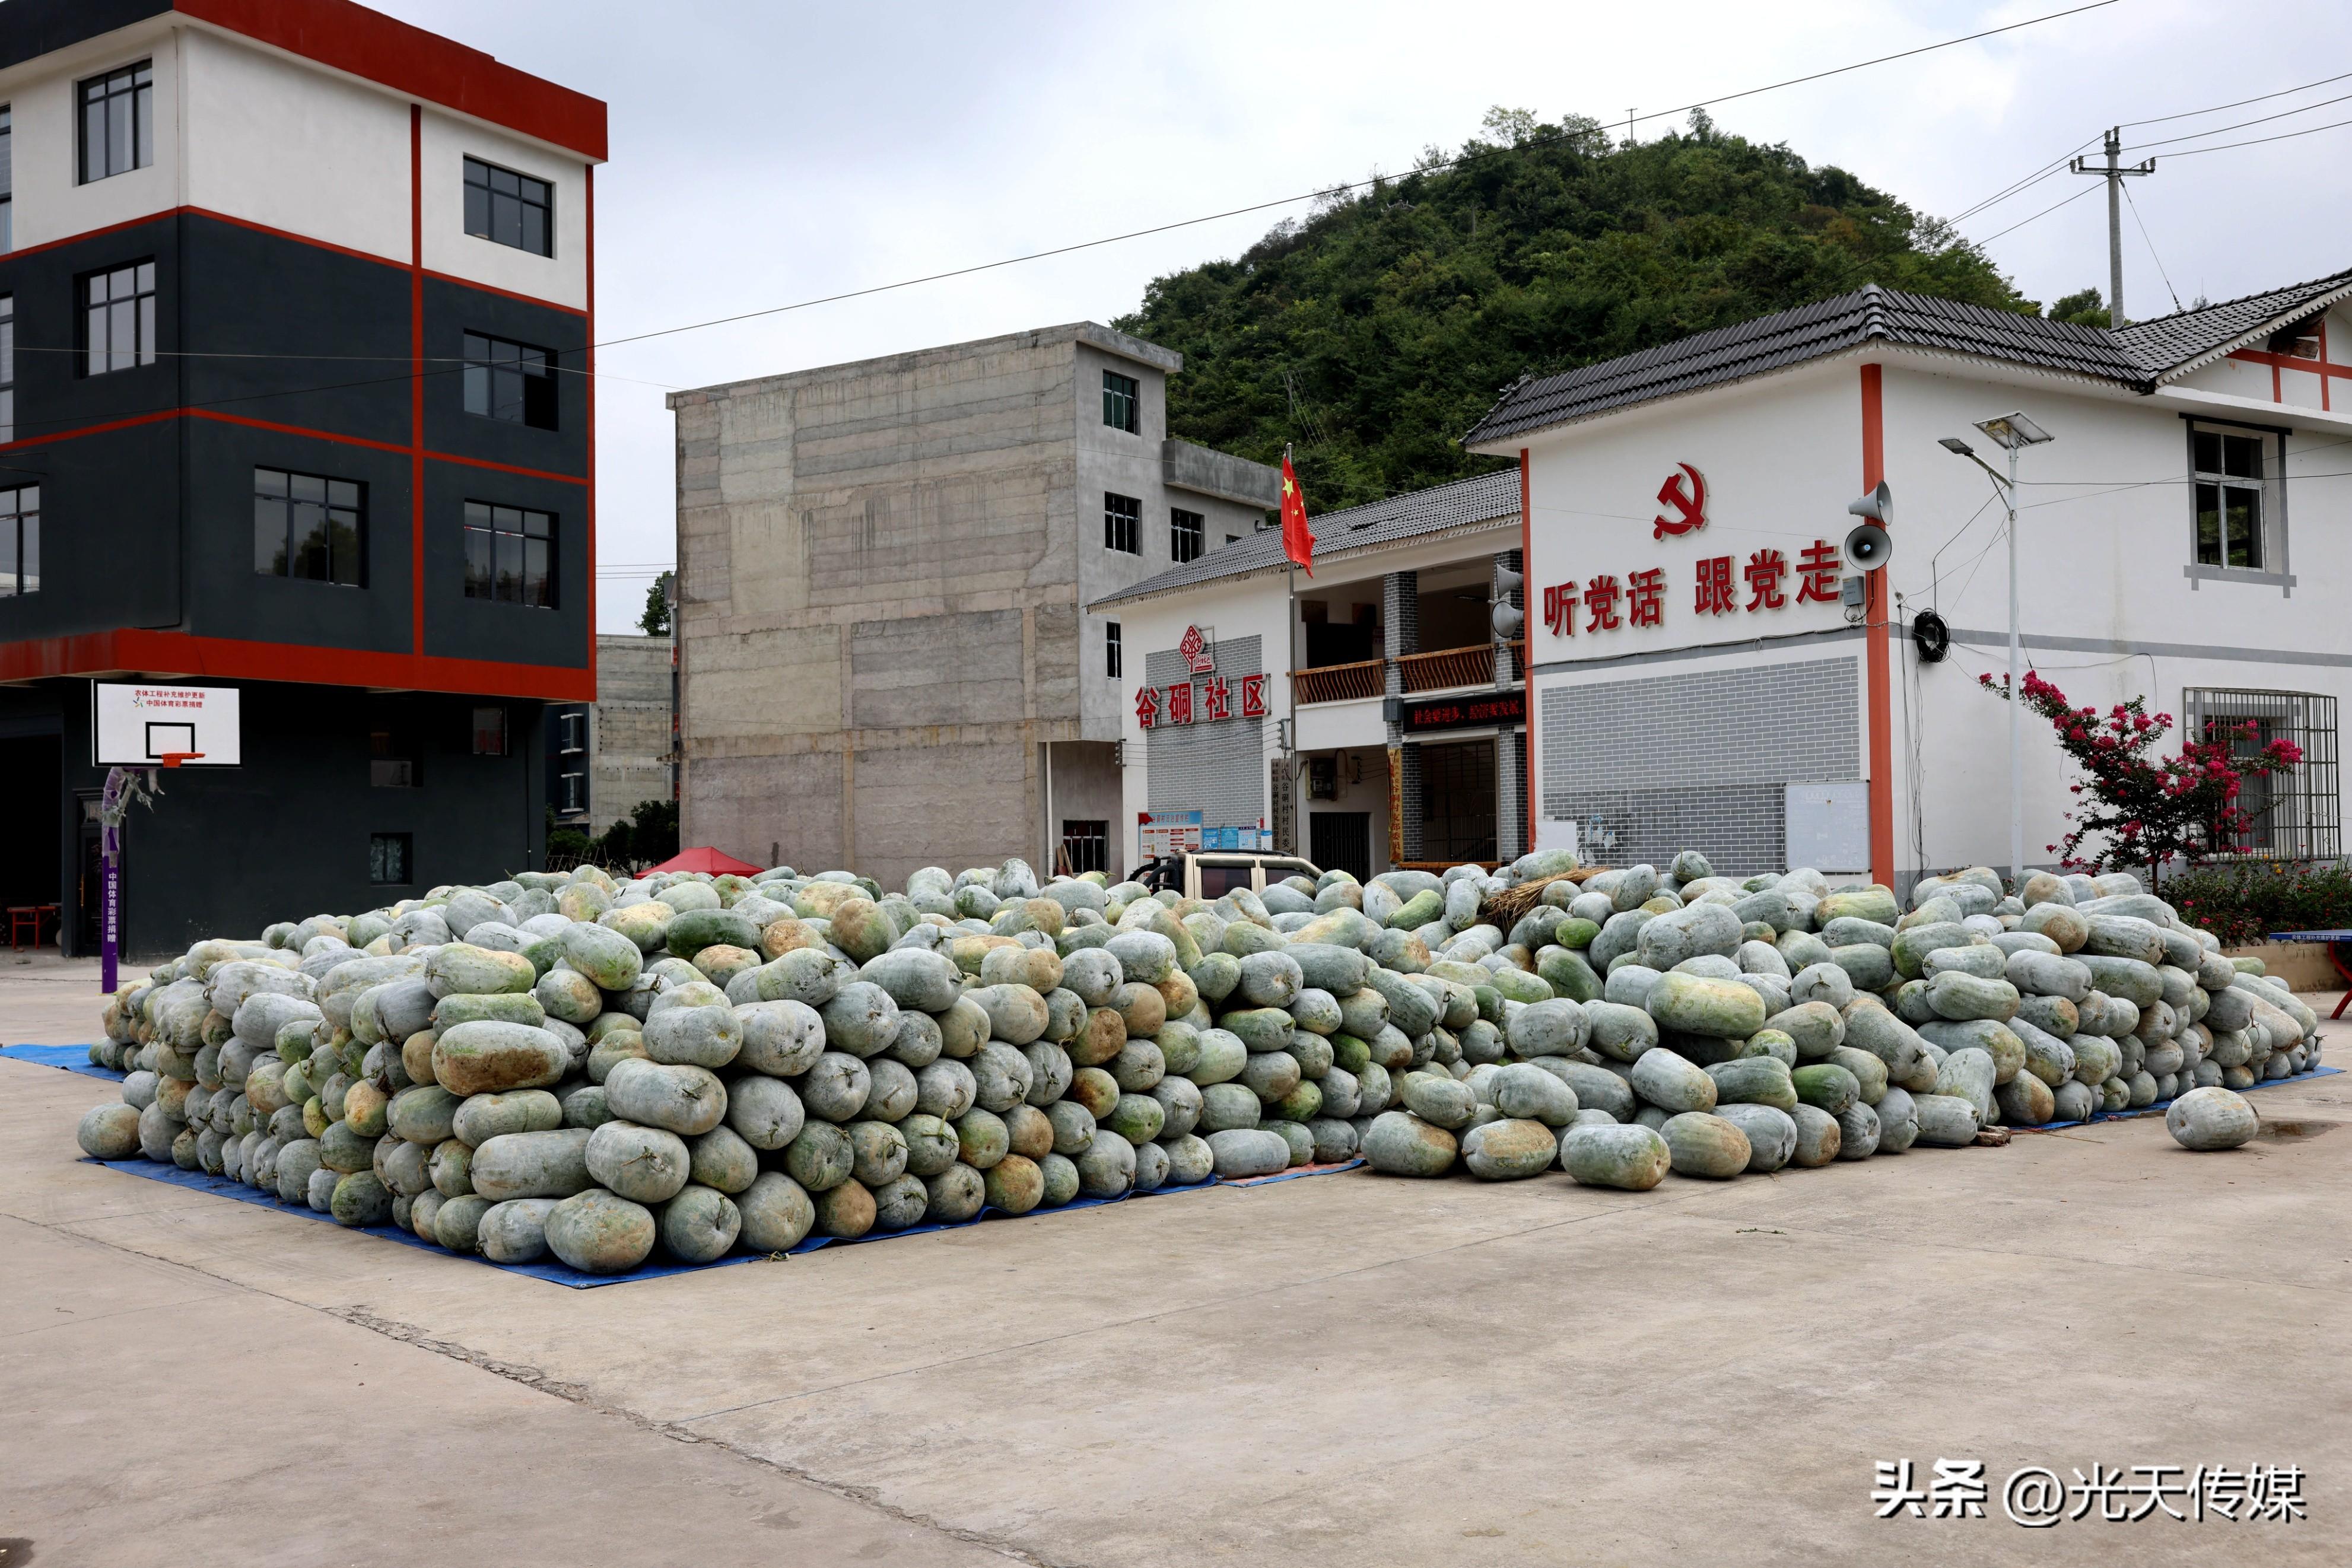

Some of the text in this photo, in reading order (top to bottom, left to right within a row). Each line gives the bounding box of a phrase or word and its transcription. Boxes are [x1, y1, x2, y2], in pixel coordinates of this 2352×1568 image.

[1543, 539, 1841, 637] 听党话 跟党走
[134, 689, 206, 699] 农体工程补充维护更新
[146, 699, 203, 708] 中国体育彩票捐赠
[1134, 673, 1266, 729] 谷硐社区
[107, 872, 117, 942] 中国体育彩票捐赠
